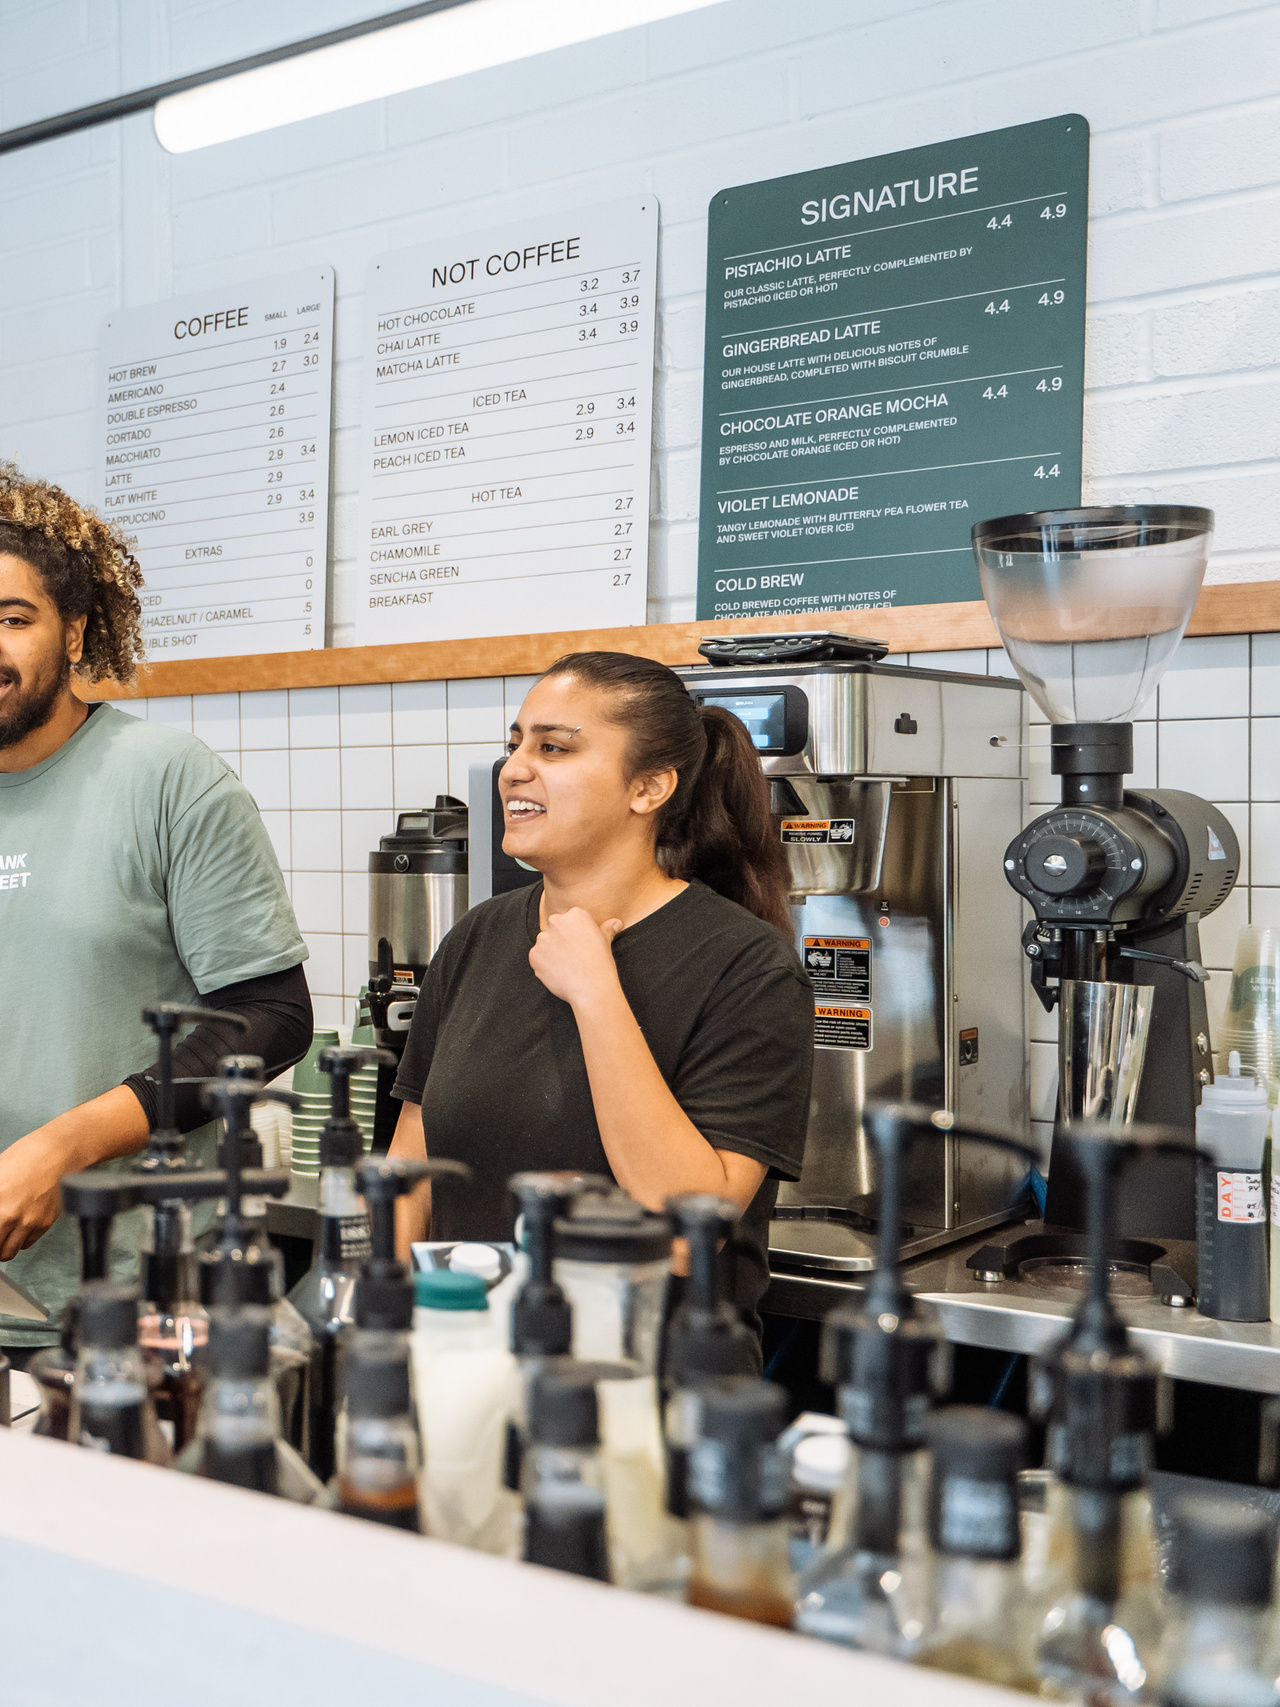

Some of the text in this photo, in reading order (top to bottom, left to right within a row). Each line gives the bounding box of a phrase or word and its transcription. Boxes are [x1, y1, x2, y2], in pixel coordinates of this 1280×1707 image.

[800, 167, 979, 226] SIGNATURE
[986, 203, 1067, 230] 4.4 4.9
[432, 236, 580, 288] NOT COFFEE
[725, 245, 852, 280] PISTACHIO LATTE
[580, 270, 640, 292] 3.2 3.7
[723, 246, 973, 299] OUR CLASSIC LATTE, PERFECTLY COMPLEMENTED BY
[579, 295, 639, 317] 3.4 3.9
[723, 283, 838, 310] PISTACHIO (ICED OR HOT)
[984, 290, 1065, 316] 4.4 4.9
[174, 306, 249, 340] COFFEE
[378, 302, 475, 332] HOT CHOCOLATE
[274, 332, 319, 350] 1.9 2.4
[578, 320, 638, 342] 3.4 3.9
[722, 320, 881, 358] GINGERBREAD LATTE
[377, 333, 440, 355] CHAI LATTE
[272, 354, 319, 373] 2.7 3.0
[376, 353, 460, 378] MATCHA LATTE
[721, 344, 969, 390] GINGERBREAD, COMPLETED WITH BISCUIT CRUMBLE
[722, 336, 938, 378] OUR HOUSE LATTE WITH DELICIOUS NOTES OF
[108, 364, 157, 383] HOT BREW
[108, 384, 164, 404] AMERICANO
[270, 383, 285, 395] 2.4
[982, 376, 1062, 400] 4.4 4.9
[472, 390, 527, 408] ICED TEA
[576, 396, 636, 416] 2.9 3.4
[107, 399, 198, 425] DOUBLE ESPRESSO
[270, 405, 285, 417] 2.6
[720, 393, 949, 436] CHOCOLATE ORANGE MOCHA
[106, 428, 151, 445] CORTADO
[269, 426, 284, 439] 2.6
[374, 422, 470, 447] LEMON ICED TEA
[576, 422, 635, 441] 2.9 3.4
[719, 416, 958, 456] ESPRESSO AND MILK, PERFECTLY COMPLEMENTED
[106, 448, 161, 466] MACCHIATO
[268, 444, 316, 461] 2.9 3.4
[373, 446, 466, 470] PEACH ICED TEA
[719, 435, 901, 466] BY CHOCOLATE ORANGE (ICED OR HOT)
[105, 473, 132, 487] LATTE
[268, 471, 283, 483] 2.9
[1034, 464, 1061, 479] 4.4
[105, 490, 157, 507] FLAT WHITE
[267, 489, 315, 505] 2.9 3.4
[472, 487, 522, 503] HOT TEA
[615, 498, 634, 510] 2.7
[717, 486, 859, 515] VIOLET LEMONADE
[299, 511, 314, 523] 3.9
[717, 499, 969, 533] TANGY LEMONADE WITH BUTTERFLY PEA FLOWER TEA
[371, 522, 433, 539] EARL GREY
[614, 523, 633, 536] 2.7
[716, 522, 855, 544] AND SWEET VIOLET (OVER ICE)
[185, 545, 222, 560] EXTRAS
[370, 544, 440, 562] CHAMOMILE
[614, 548, 632, 561] 2.7
[370, 566, 460, 585] SENCHA GREEN
[613, 574, 631, 586] 2.7
[715, 572, 805, 594] COLD BREW
[369, 592, 434, 608] BREAKFAST
[714, 589, 897, 612] COLD BREWED COFFEE WITH NOTES OF
[146, 608, 254, 627] HAZELNUT CARAMEL
[171, 635, 198, 647] SHOT
[818, 1008, 863, 1017] WARNING
[1221, 1177, 1231, 1217] DAY
